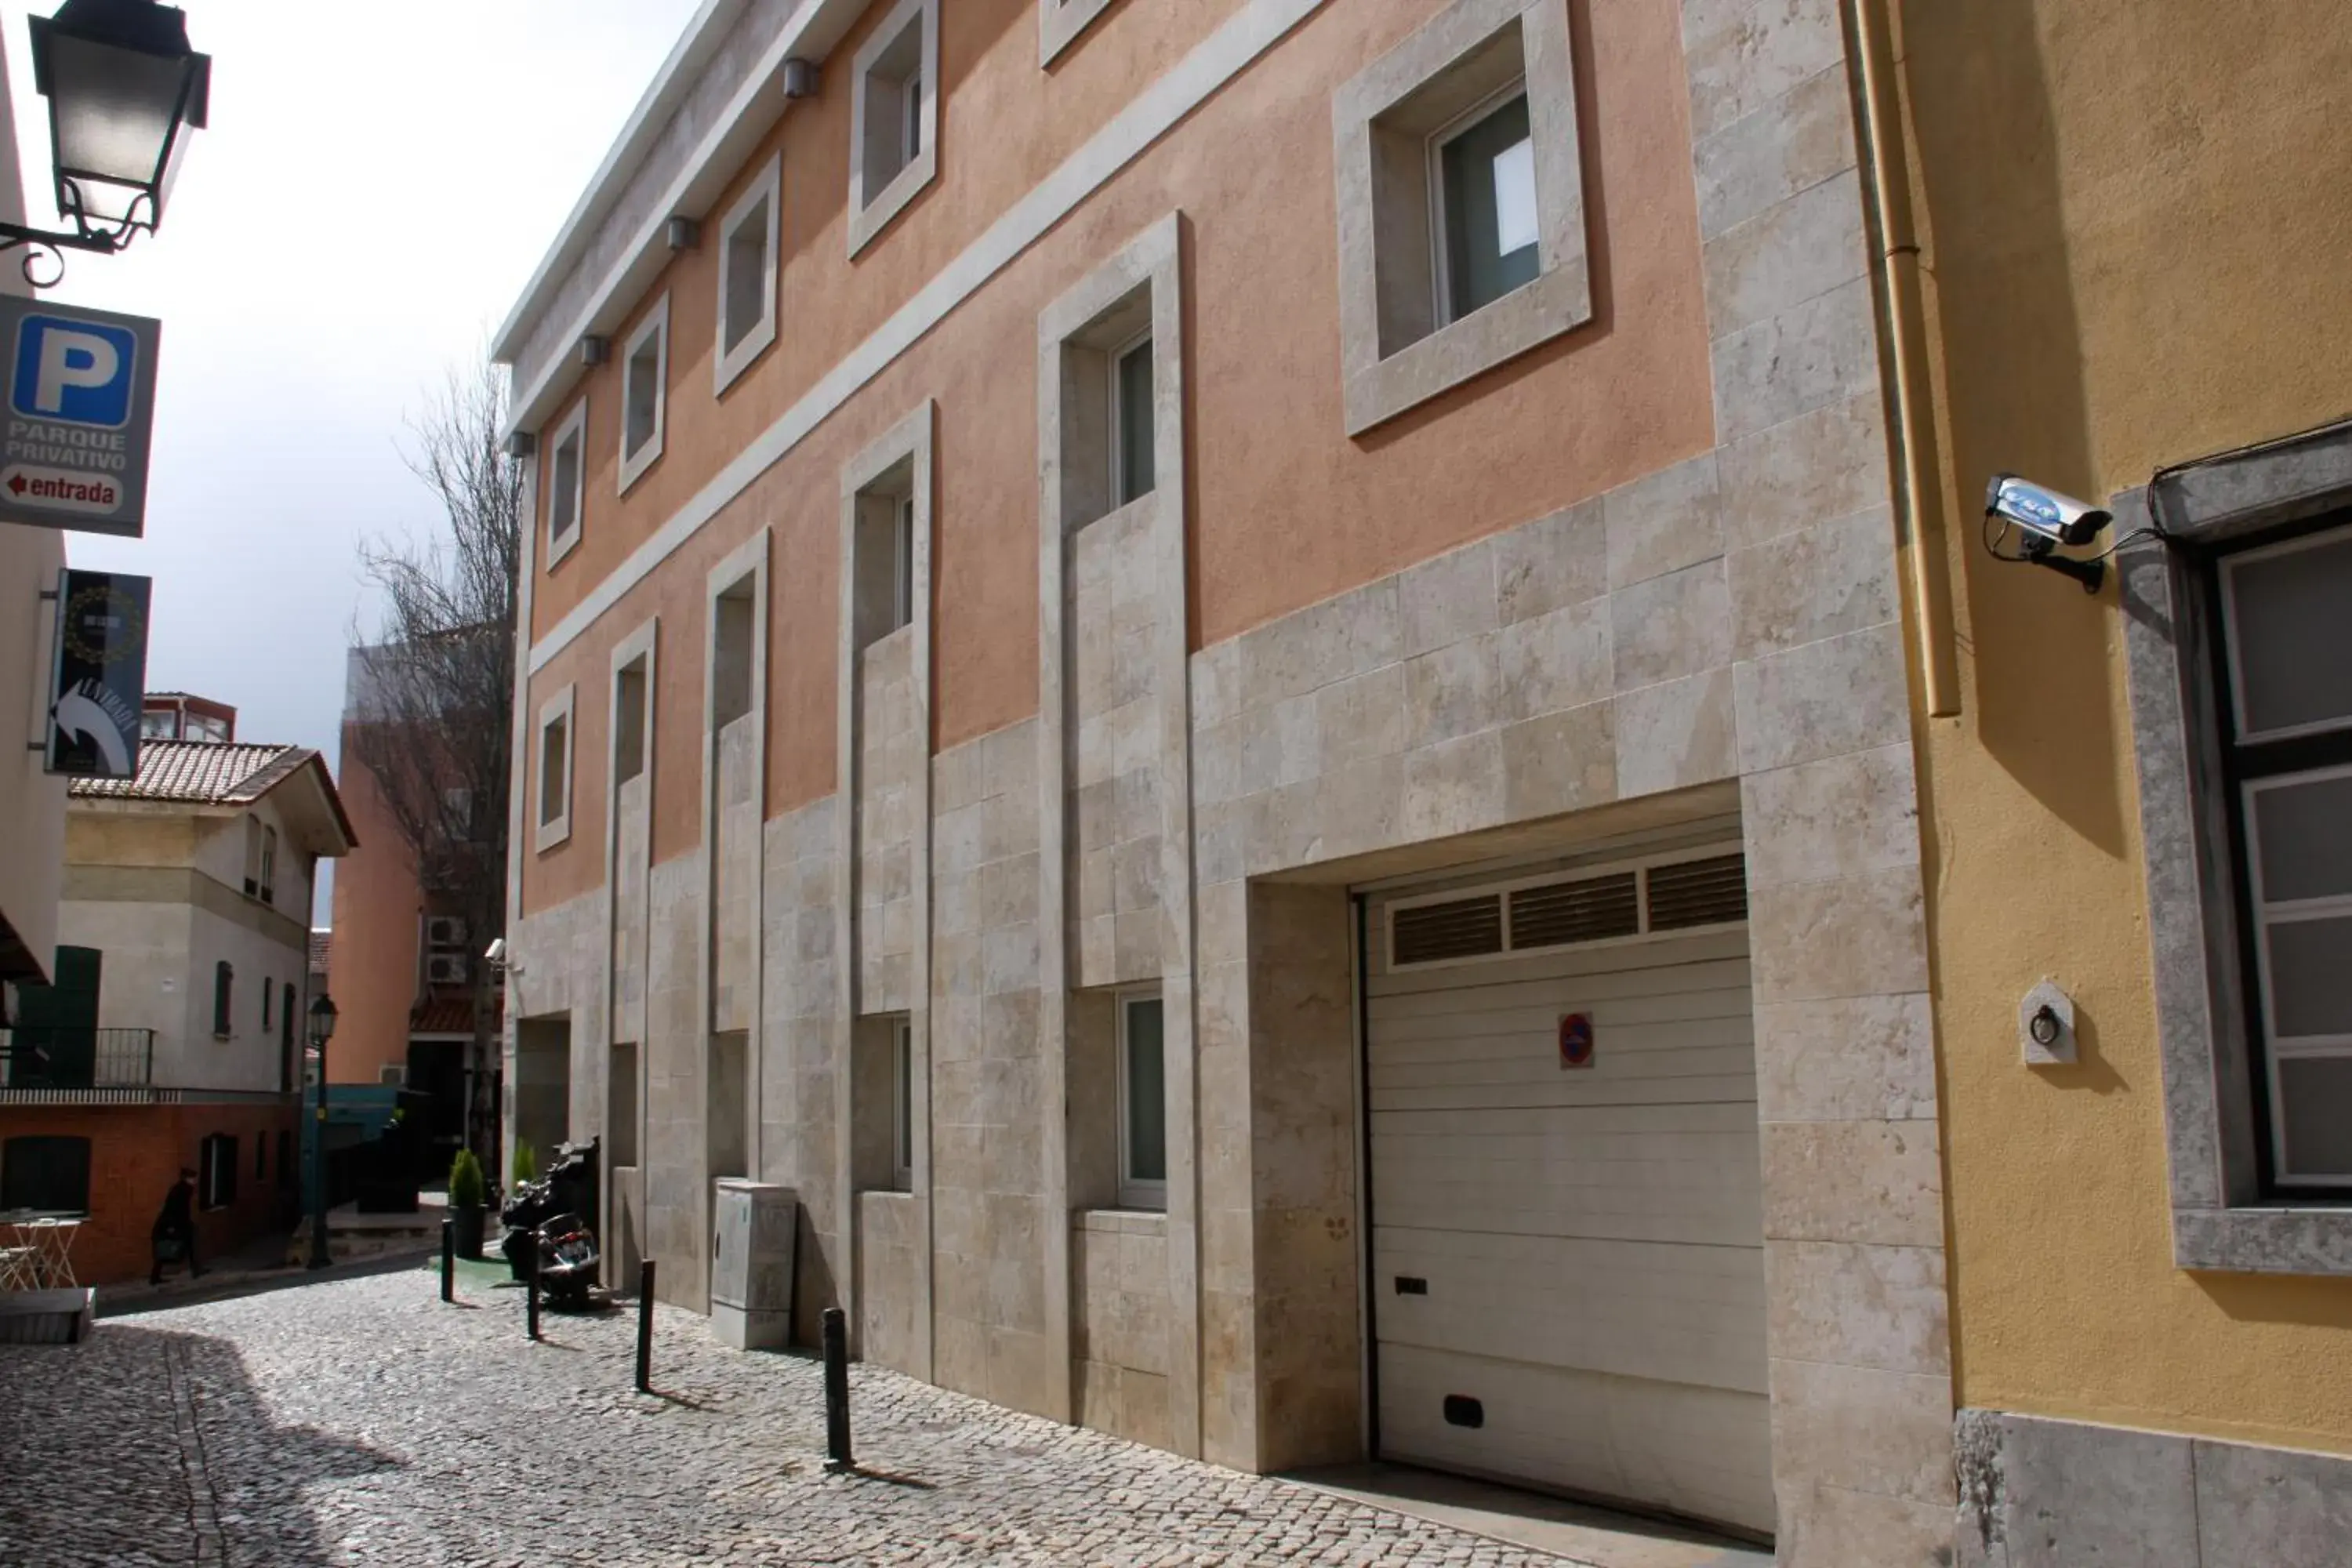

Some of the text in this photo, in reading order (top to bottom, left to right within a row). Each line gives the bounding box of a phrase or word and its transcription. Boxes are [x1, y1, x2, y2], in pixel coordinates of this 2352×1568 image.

[34, 327, 118, 412] P
[9, 422, 125, 450] PARQUE
[6, 440, 125, 470] PRIVATIVO
[31, 478, 114, 503] entrada
